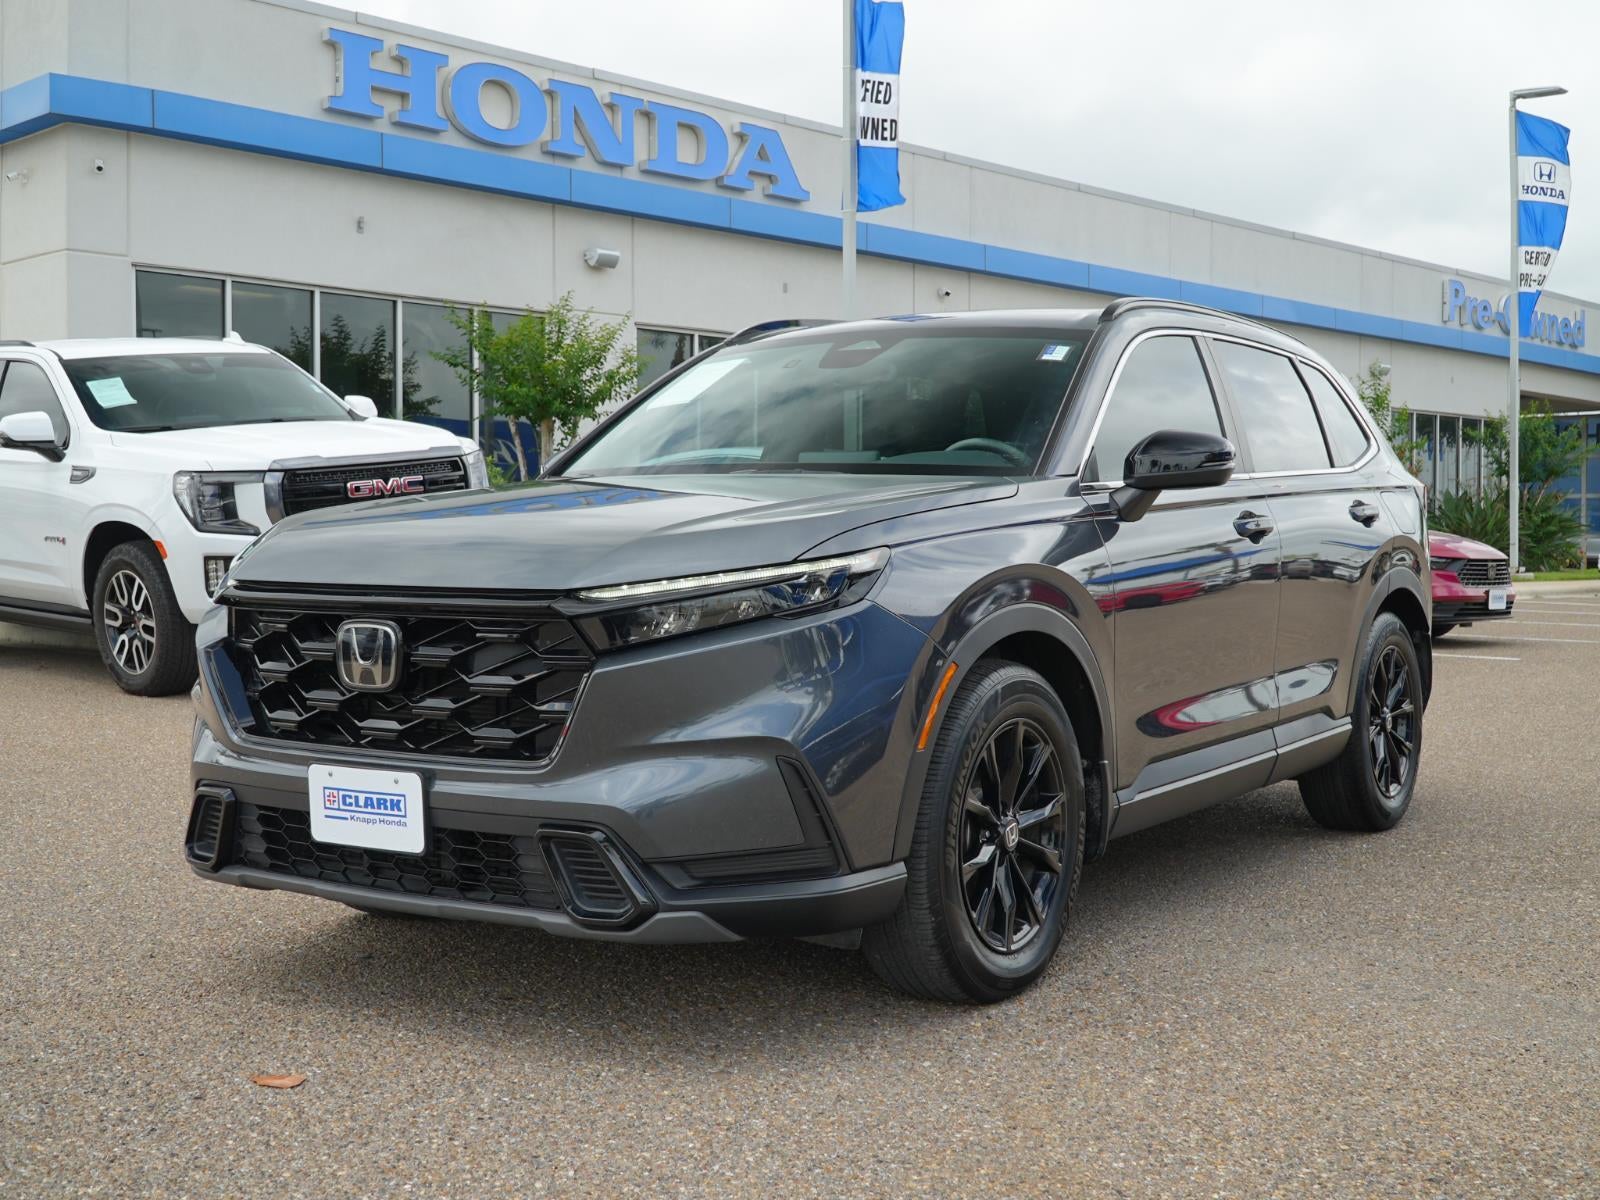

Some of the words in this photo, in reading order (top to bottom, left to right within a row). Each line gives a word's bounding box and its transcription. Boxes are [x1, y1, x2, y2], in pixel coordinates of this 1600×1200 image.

[322, 27, 810, 202] HONDA
[1521, 184, 1566, 200] HONDA
[347, 475, 424, 498] GMC
[341, 793, 402, 812] CLARK
[349, 815, 377, 825] Knapp
[379, 818, 407, 827] Honda
